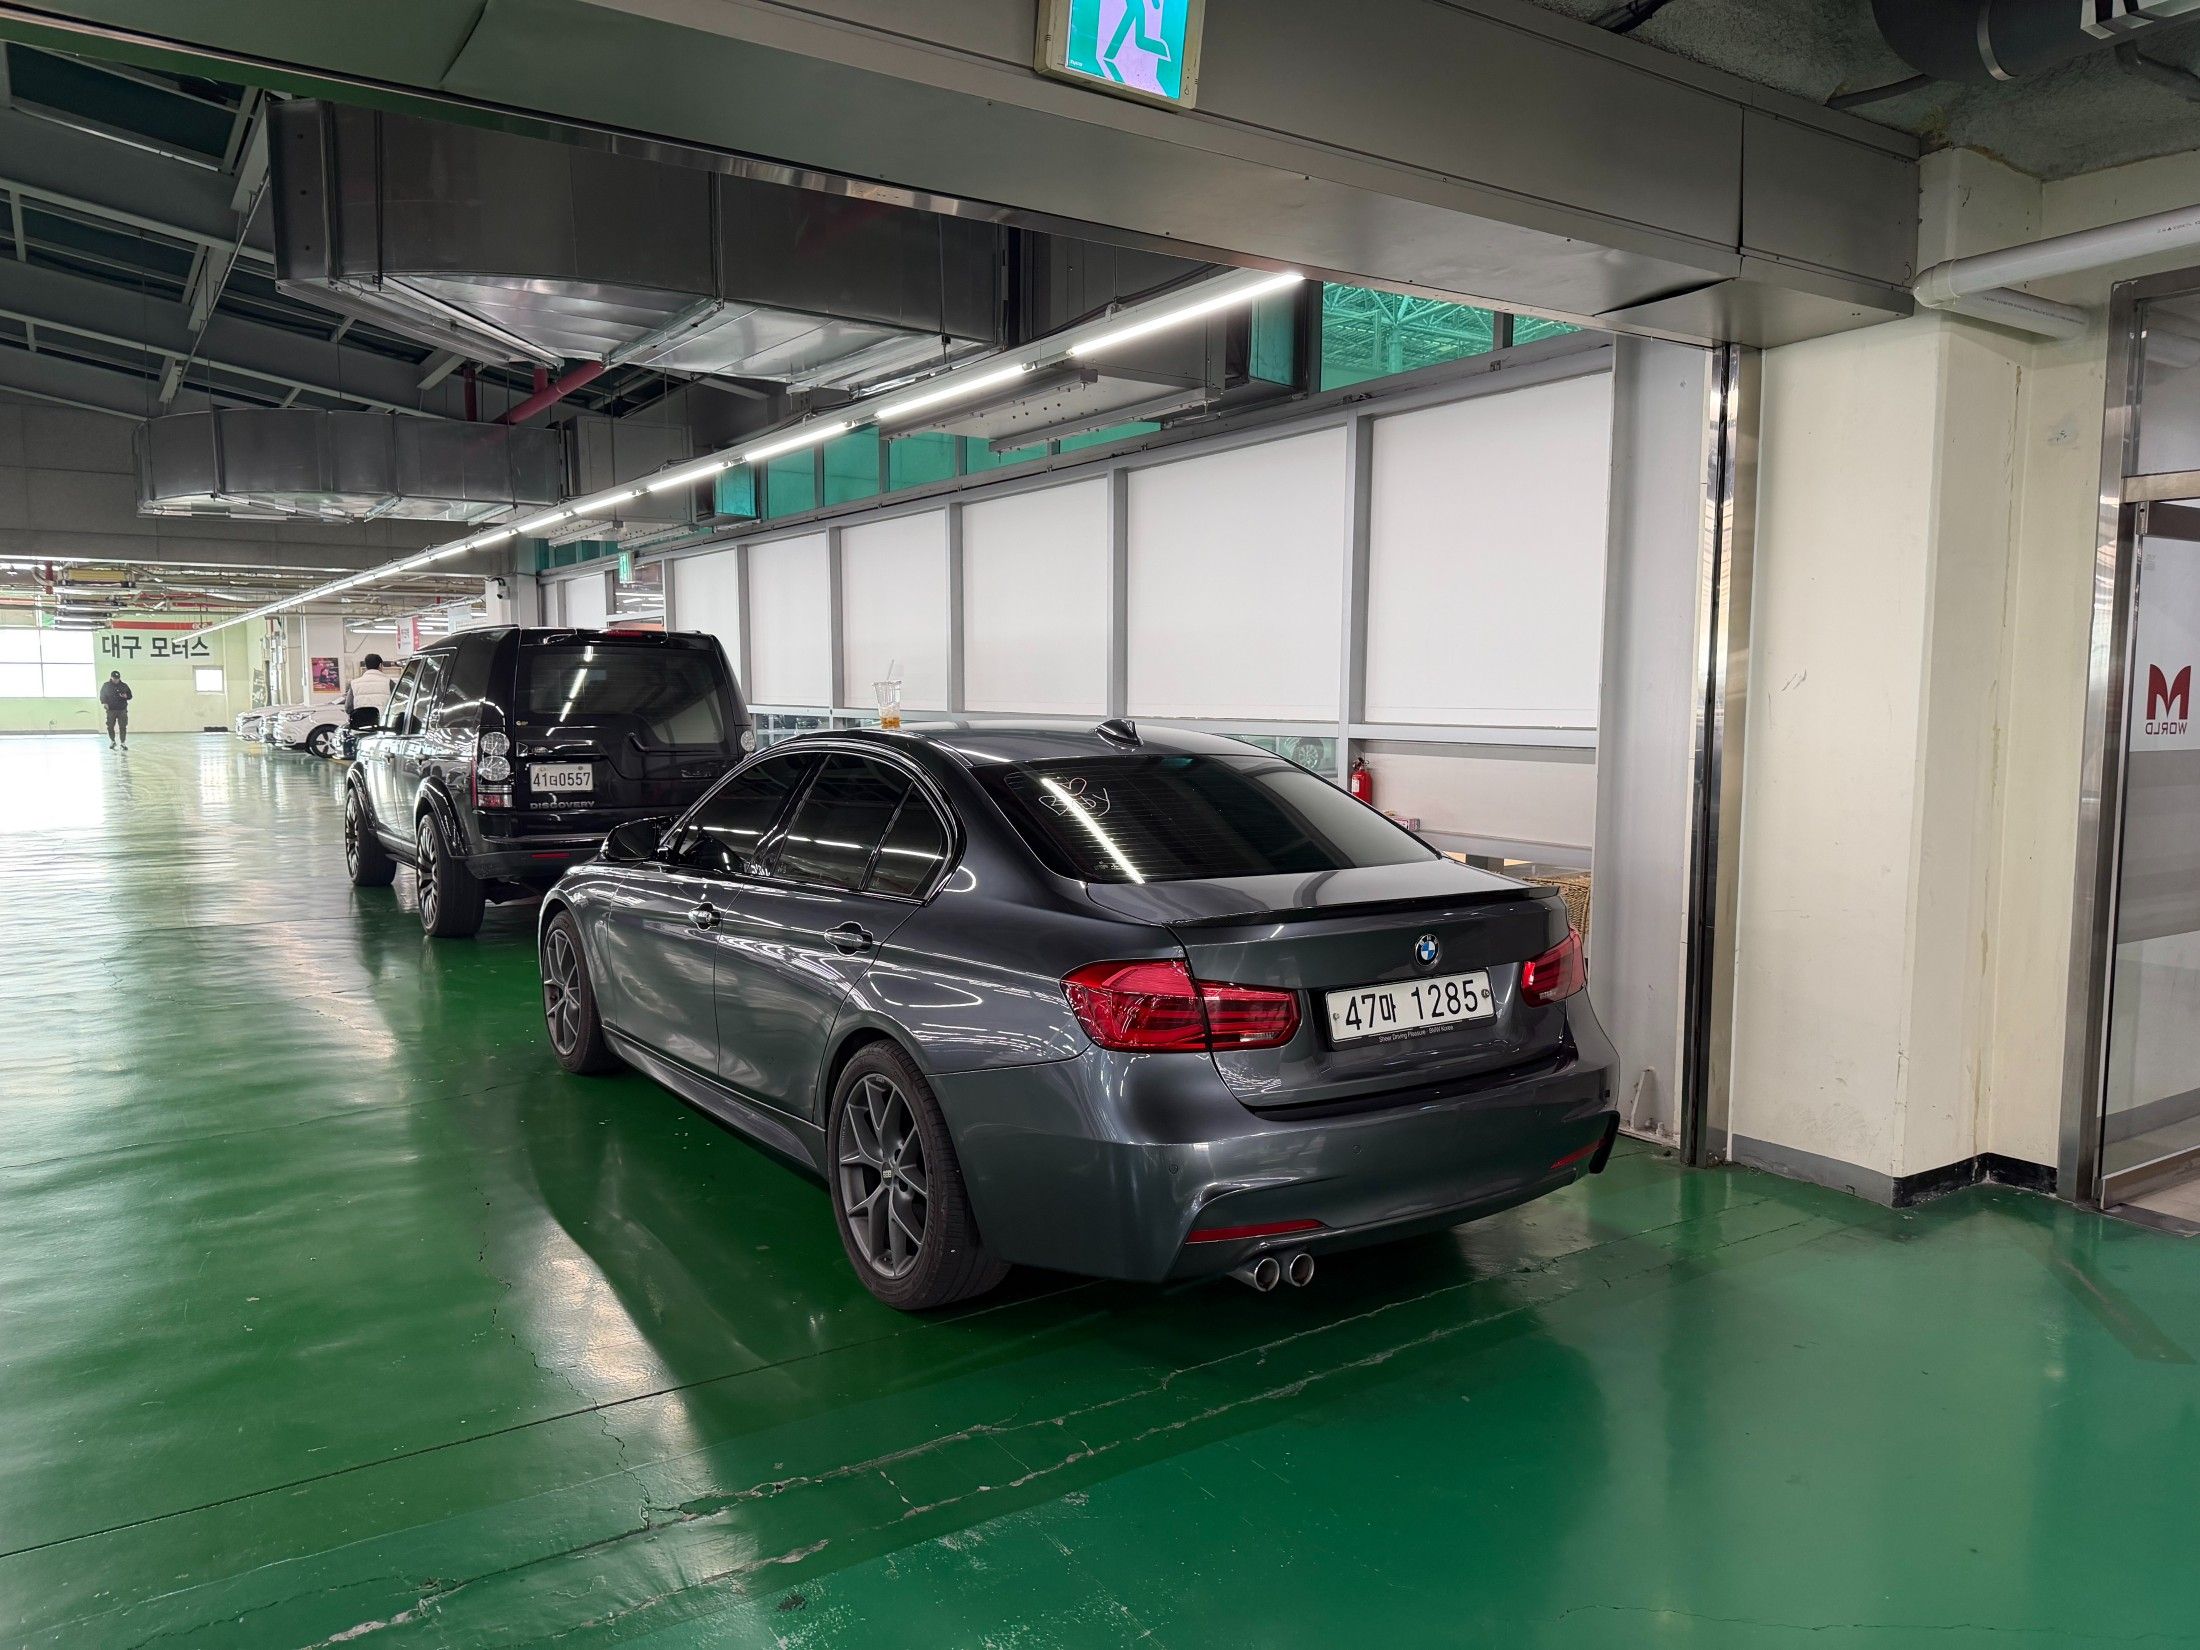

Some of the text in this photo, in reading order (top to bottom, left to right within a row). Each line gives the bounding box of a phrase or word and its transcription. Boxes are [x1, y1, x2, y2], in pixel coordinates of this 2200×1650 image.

[101, 635, 210, 659] 대구 모터스
[533, 772, 590, 787] 41더0557
[530, 801, 595, 810] DISCOVERY
[1346, 980, 1478, 1030] 47마 1285
[1393, 1031, 1407, 1039] Driving
[1407, 1029, 1426, 1037] Pleasure
